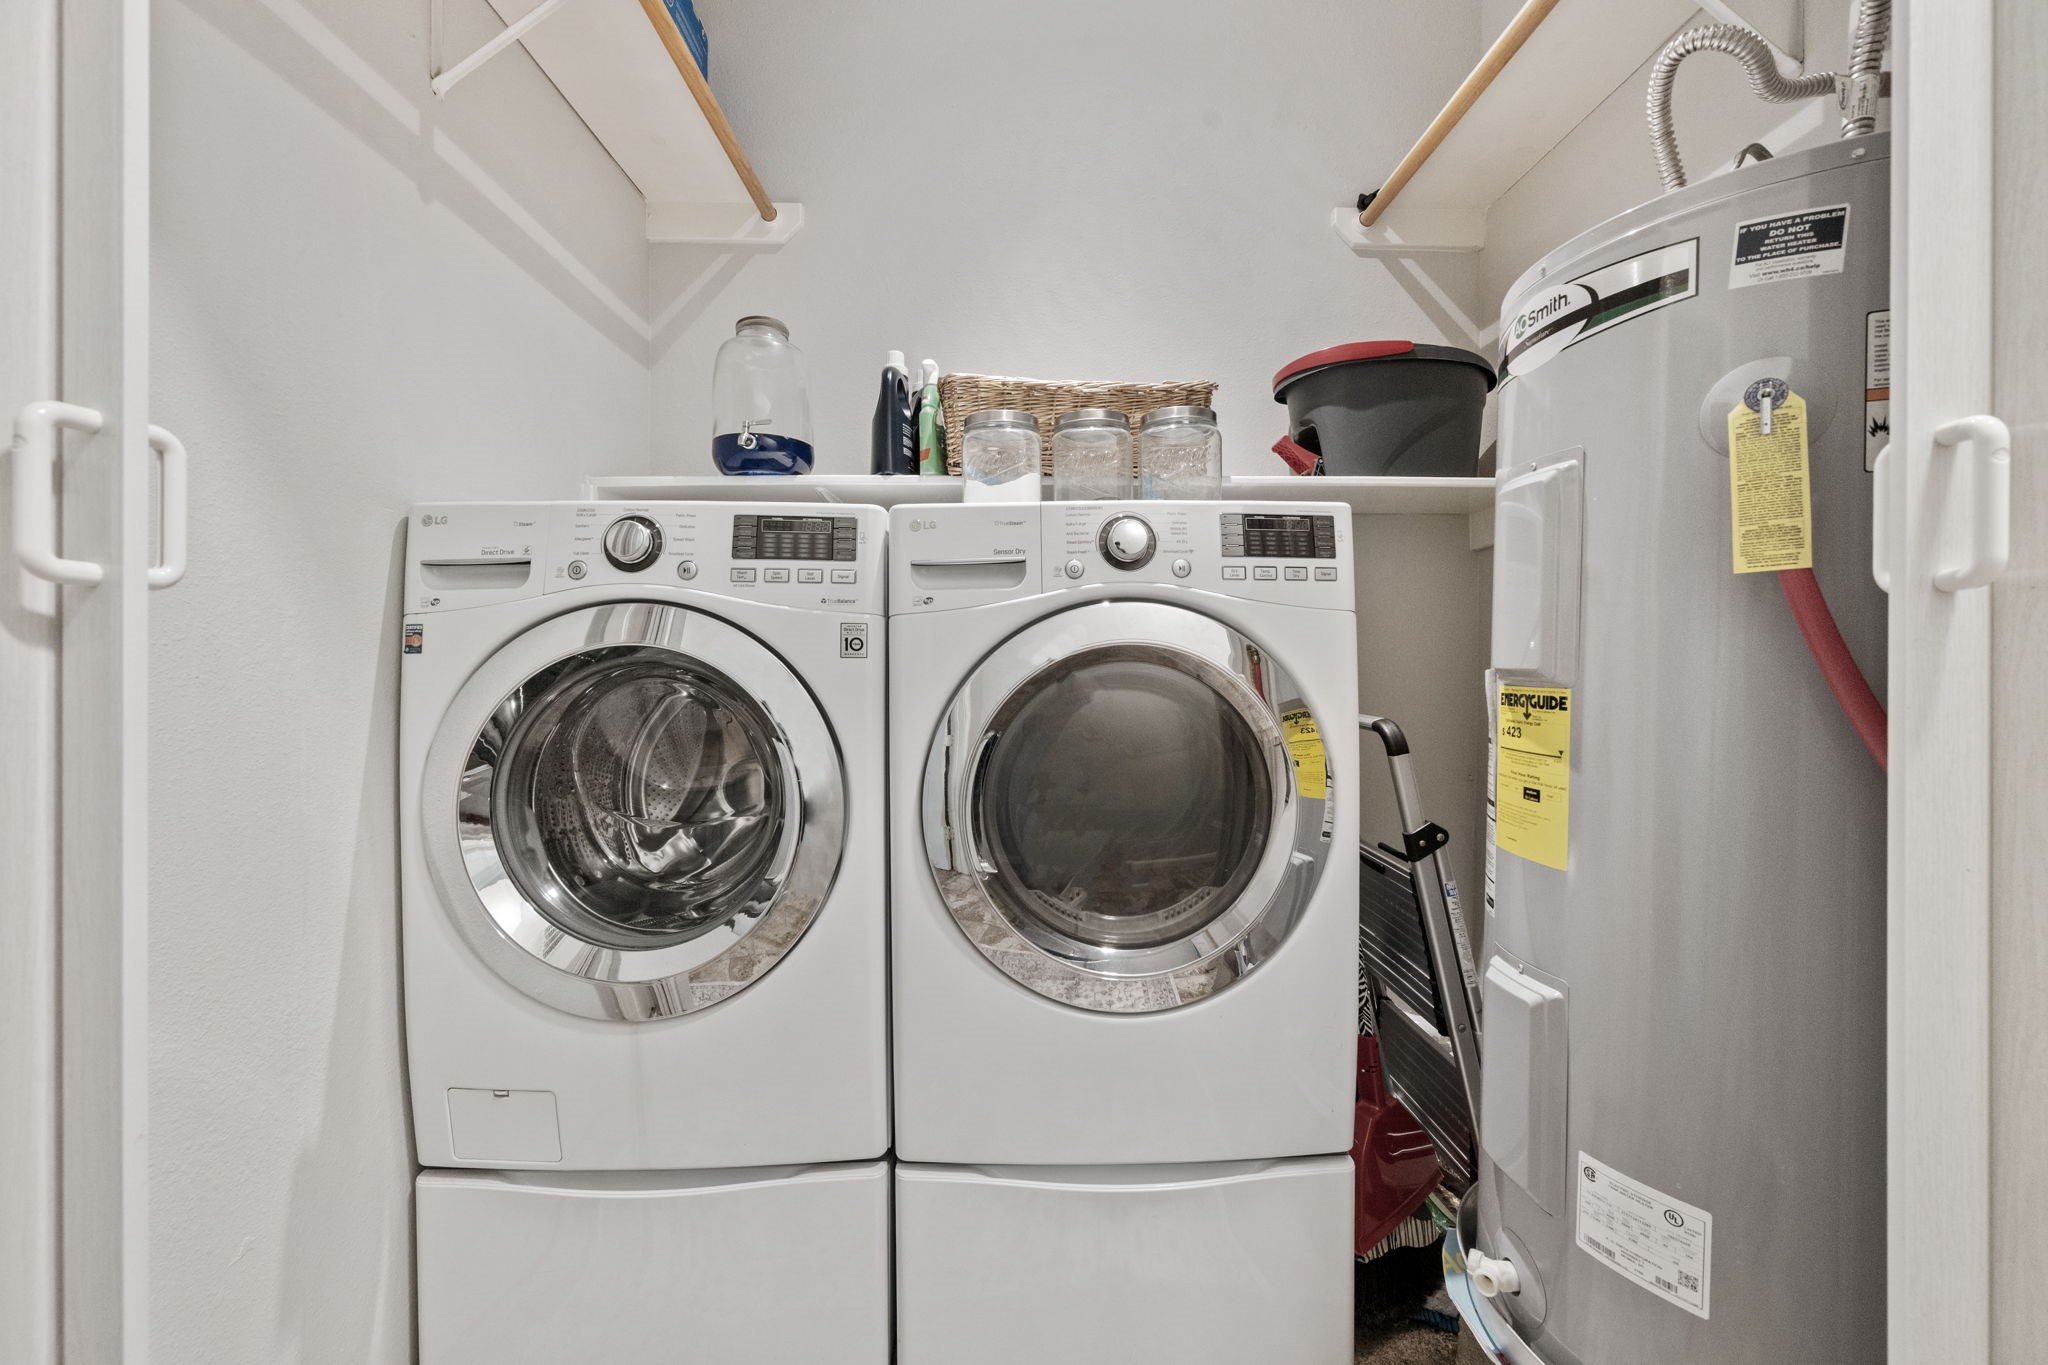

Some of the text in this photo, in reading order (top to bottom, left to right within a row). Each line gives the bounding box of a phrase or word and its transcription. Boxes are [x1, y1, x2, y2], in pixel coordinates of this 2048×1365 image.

[1749, 224, 1768, 232] YOU
[1769, 218, 1793, 228] HAVE
[1802, 210, 1845, 222] PROBLEM
[1764, 231, 1815, 245] RETURN THIS
[1769, 223, 1812, 238] DO NOT
[1759, 237, 1817, 252] WATER HEATER
[1736, 256, 1746, 264] TO
[1746, 253, 1762, 261] THE
[1762, 249, 1786, 258] PLACE
[434, 516, 448, 525] LG
[923, 520, 937, 530] LG
[1015, 547, 1026, 555] Dry
[844, 637, 864, 652] 10
[1501, 692, 1568, 712] ENERGYGUIDE
[1668, 1213, 1679, 1225] UL
